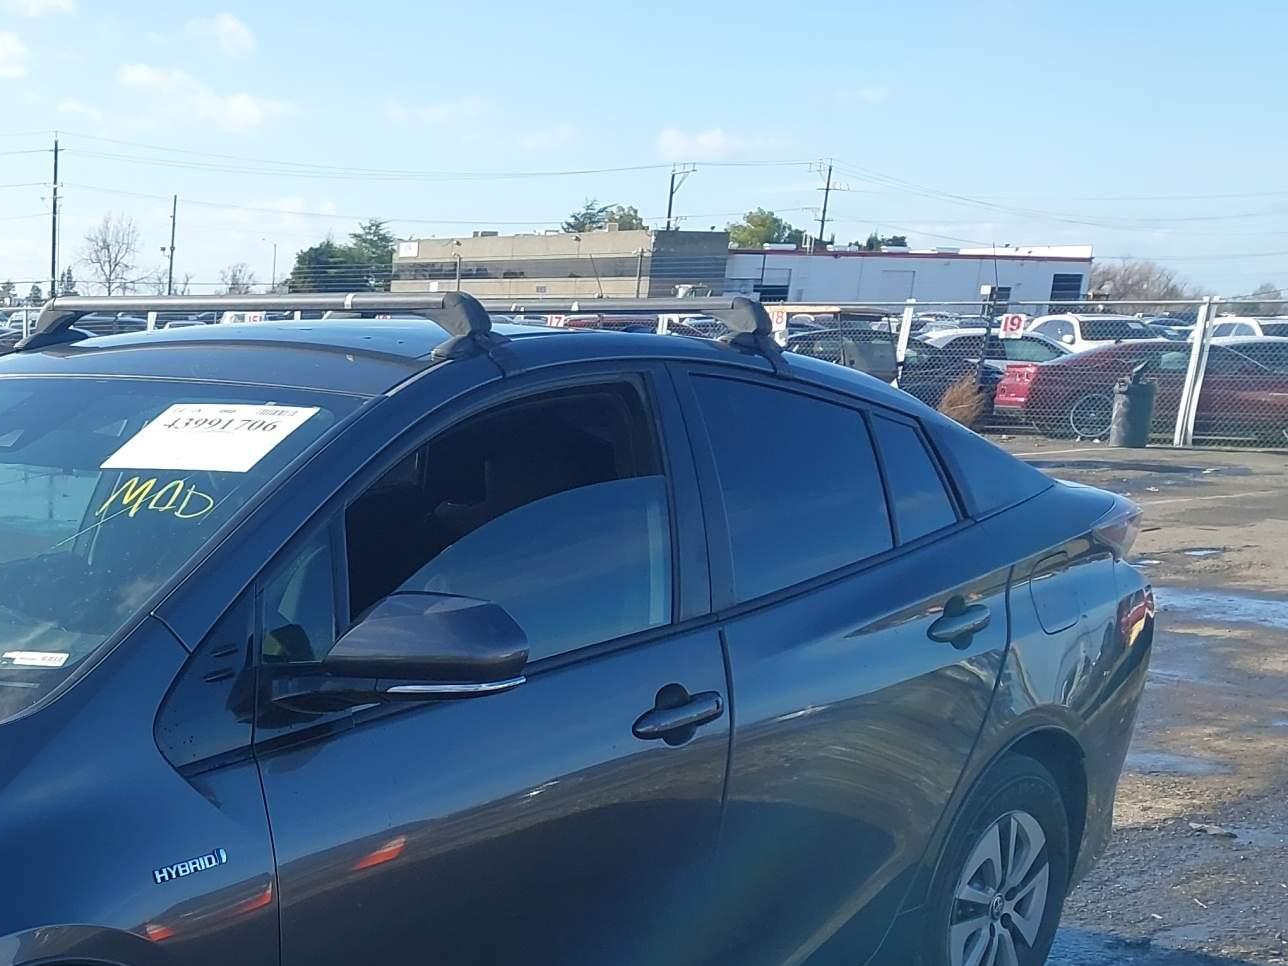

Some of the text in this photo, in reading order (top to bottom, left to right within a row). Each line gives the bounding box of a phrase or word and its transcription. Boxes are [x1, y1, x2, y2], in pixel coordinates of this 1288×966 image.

[1003, 315, 1022, 332] 19
[163, 417, 279, 432] 43991706
[154, 853, 217, 884] HYBRID
